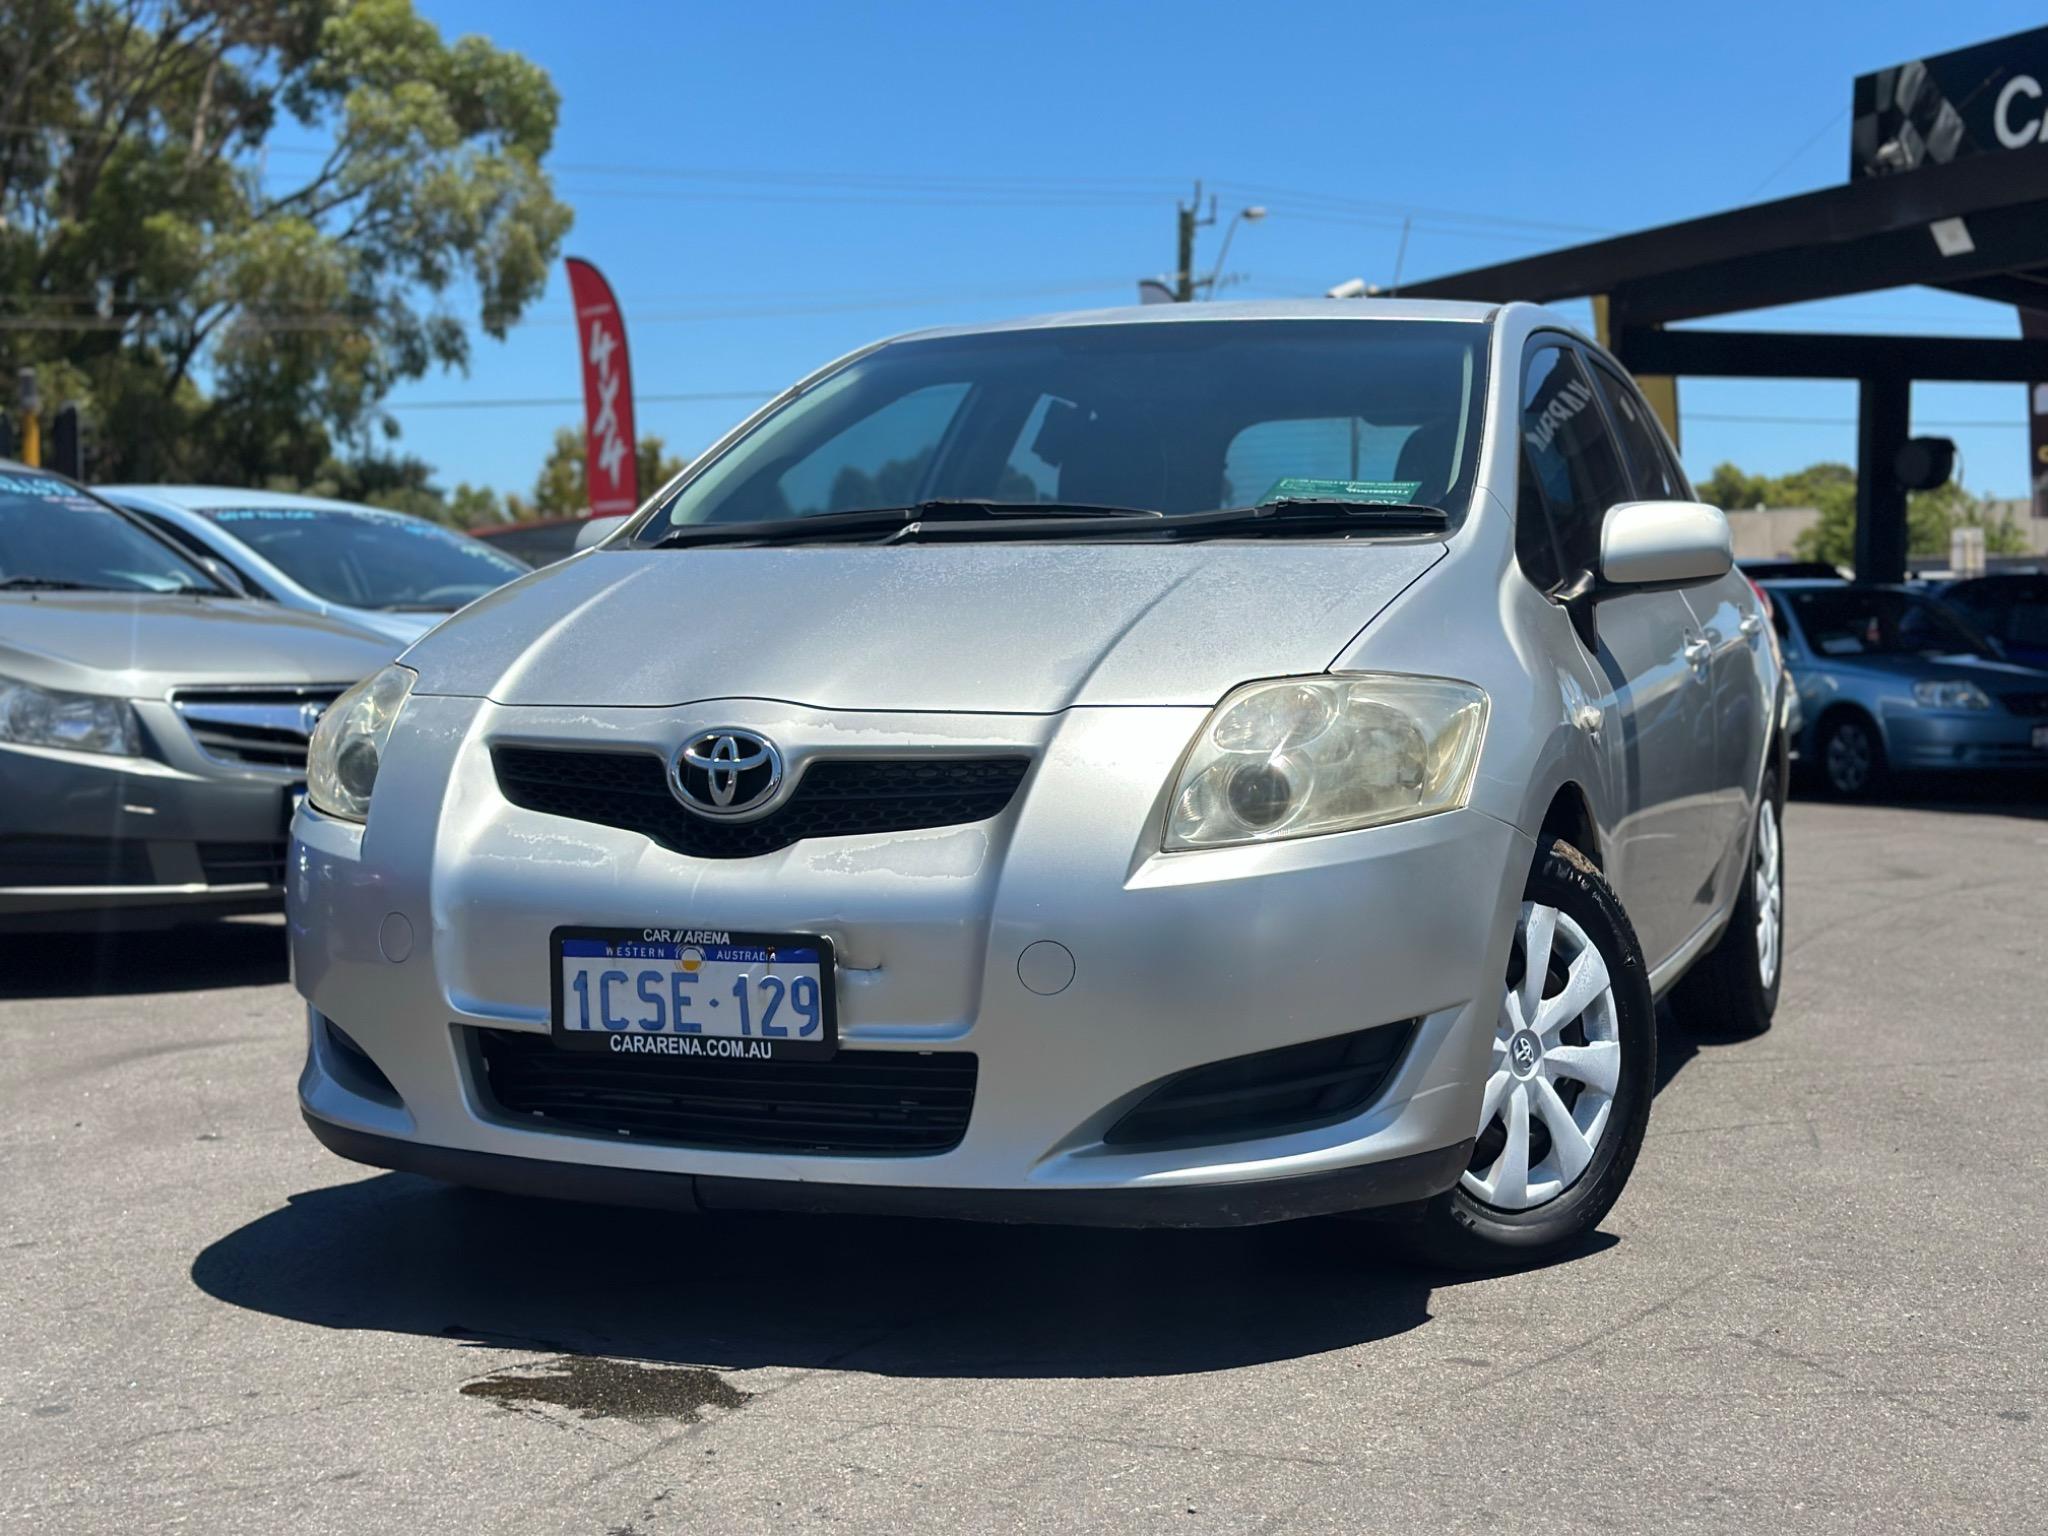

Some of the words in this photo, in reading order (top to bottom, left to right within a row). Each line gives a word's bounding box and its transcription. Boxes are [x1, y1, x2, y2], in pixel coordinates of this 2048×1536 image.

[1994, 74, 2048, 149] C
[605, 946, 665, 958] WESTERN
[716, 950, 777, 962] AUSTRALIA
[610, 1034, 772, 1059] CARARENA.COM.AU
